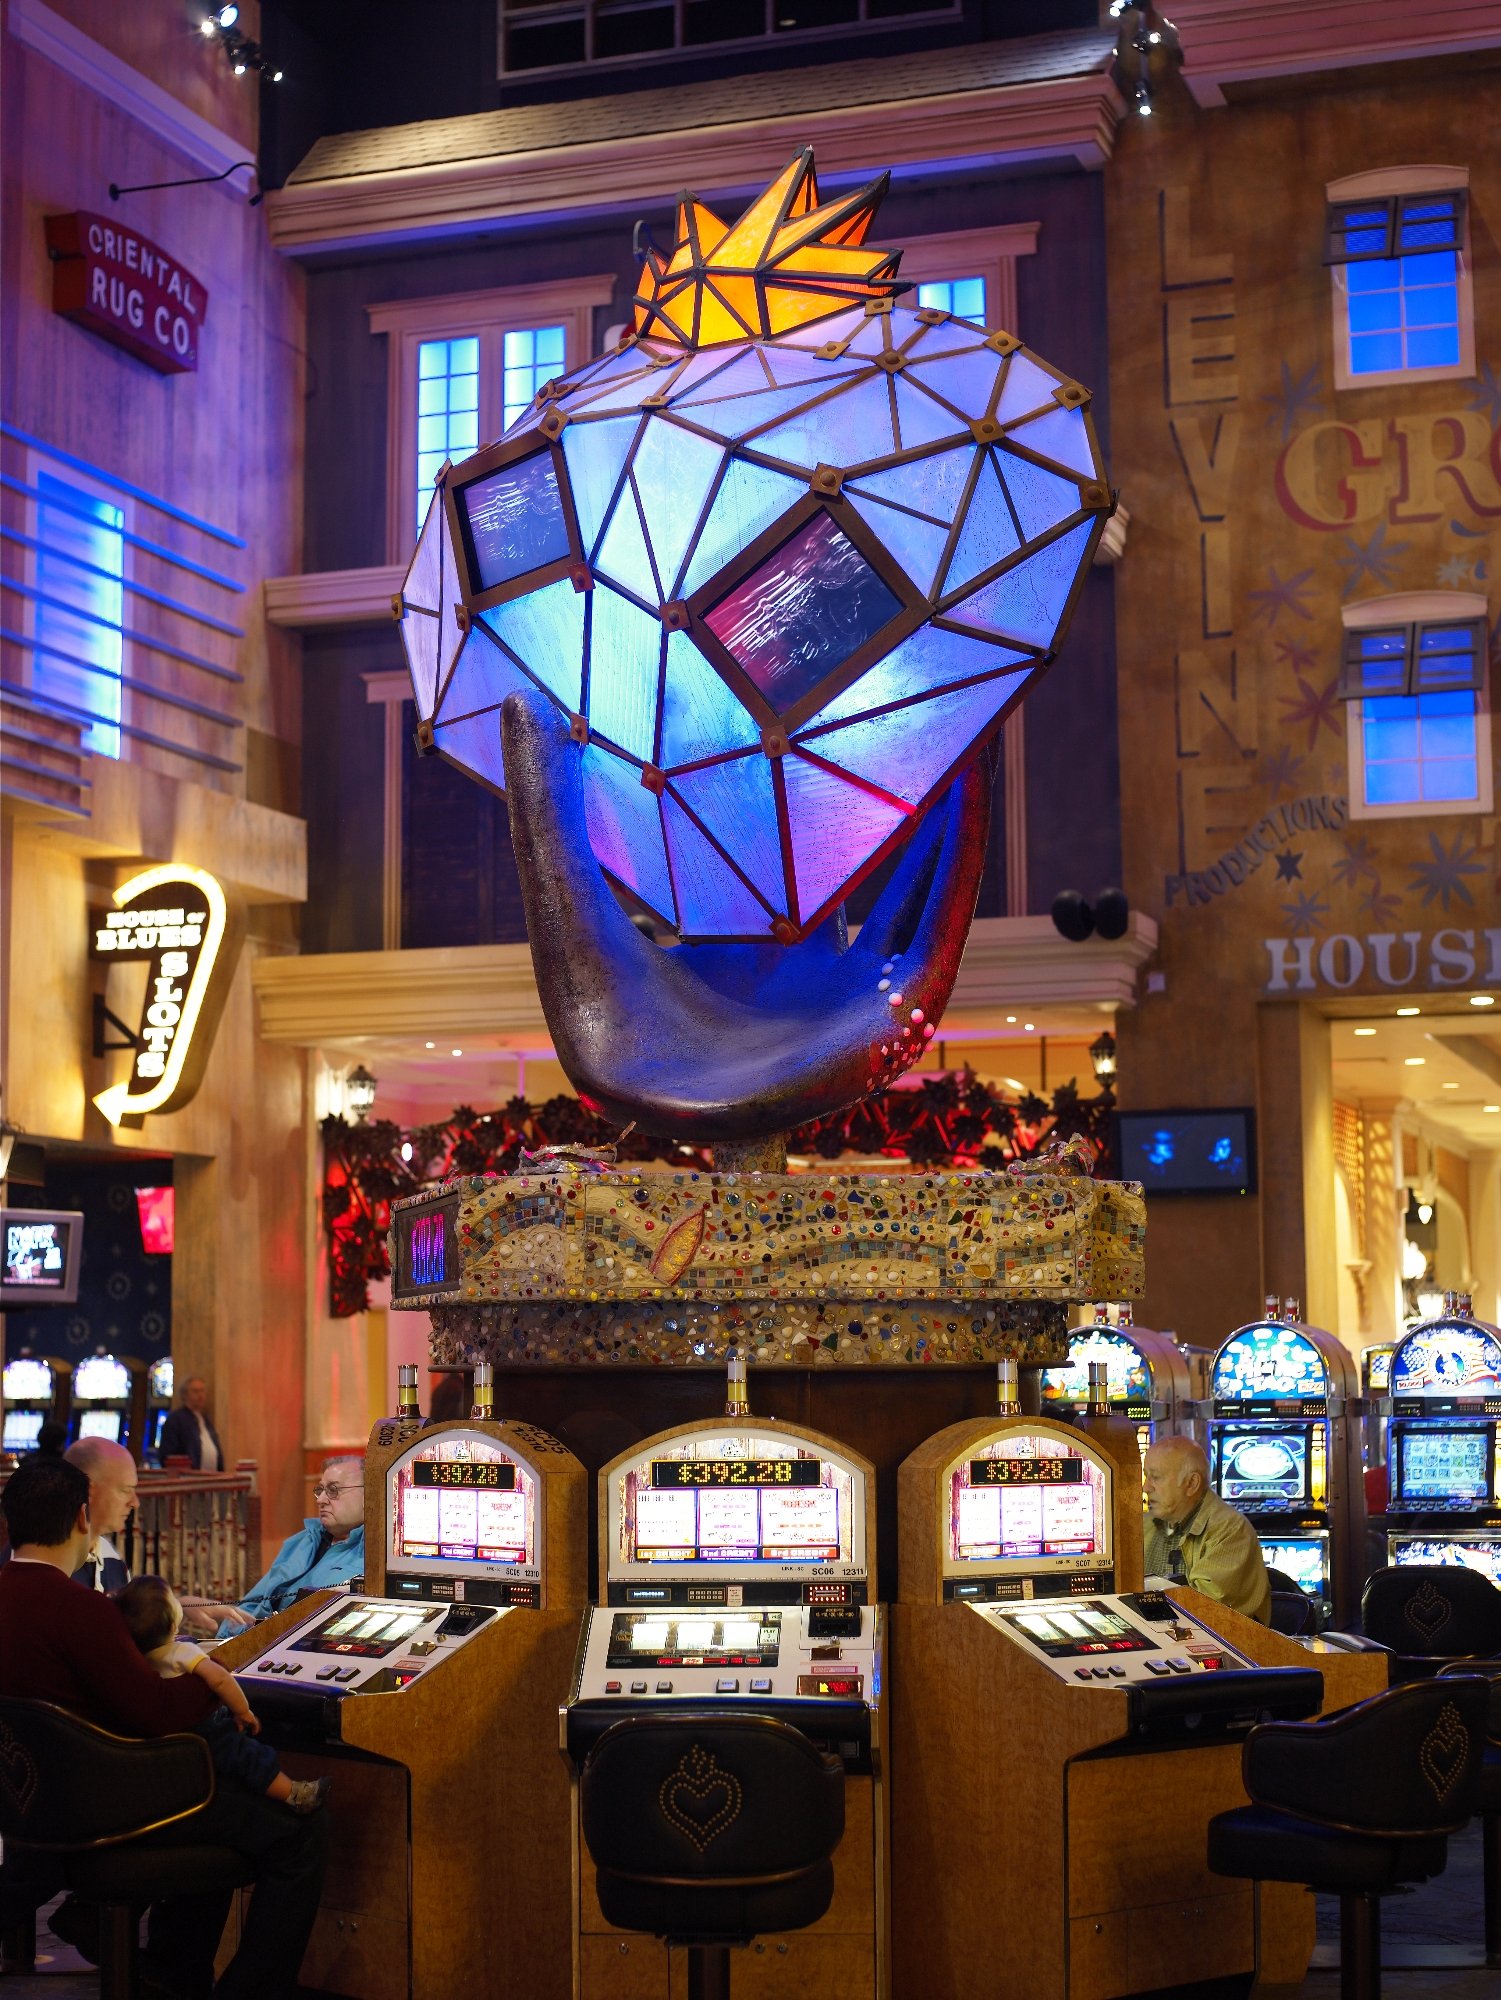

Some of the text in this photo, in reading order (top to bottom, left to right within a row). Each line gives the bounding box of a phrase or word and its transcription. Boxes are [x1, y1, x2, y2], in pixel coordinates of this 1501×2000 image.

[88, 224, 196, 315] ORIENTAL
[92, 266, 190, 355] RUG CO
[1274, 410, 1501, 532] GR
[1164, 794, 1349, 908] PRODUCTIONS
[106, 908, 185, 929] HOUSE
[95, 925, 201, 951] BLUES
[136, 951, 189, 1078] SLOTS
[430, 1464, 499, 1485] $392.28
[678, 1462, 792, 1483] $392.28
[986, 1460, 1063, 1481] $392.28
[811, 1567, 834, 1576] SC06
